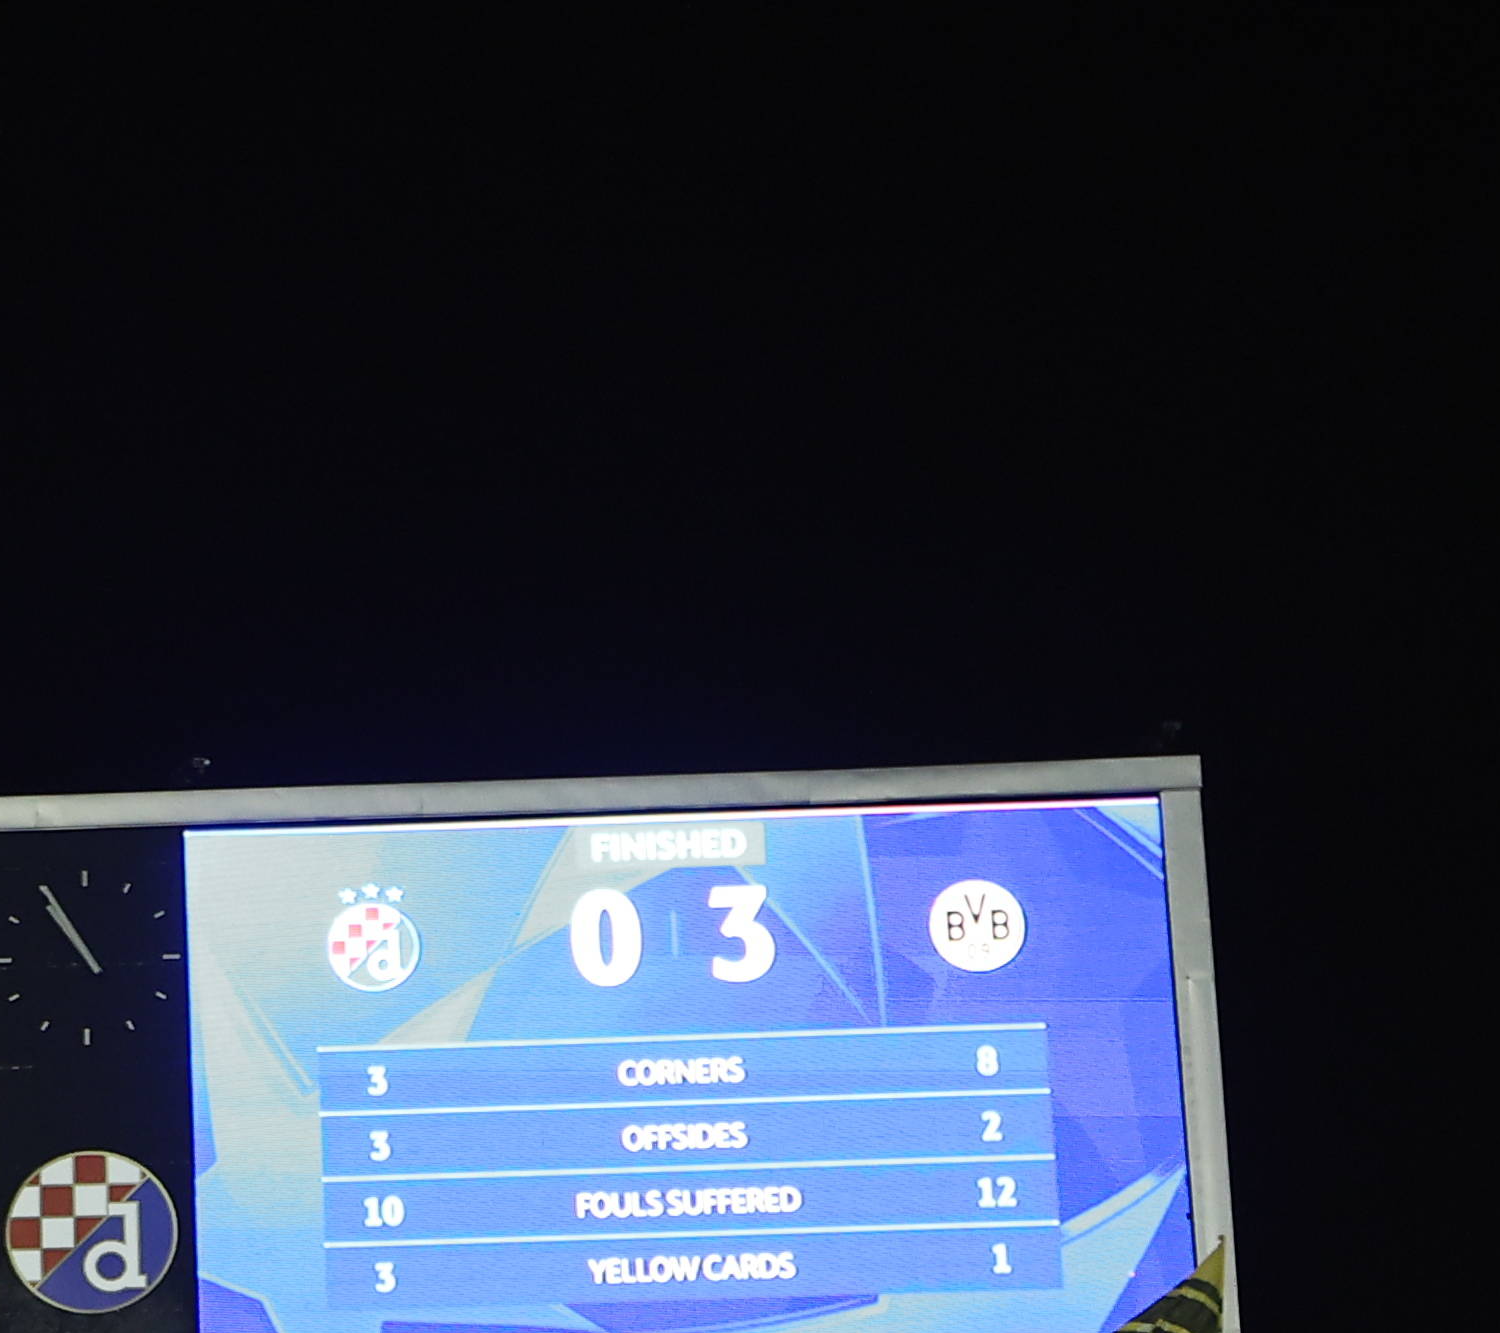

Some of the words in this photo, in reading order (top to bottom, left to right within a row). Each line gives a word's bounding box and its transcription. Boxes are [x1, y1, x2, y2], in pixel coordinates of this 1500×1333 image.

[590, 828, 747, 862] FINISHED
[571, 888, 643, 987] 0
[708, 884, 776, 983] 3
[946, 893, 1010, 941] BVB
[367, 1066, 388, 1096] 3
[616, 1056, 746, 1086] CORNERS
[976, 1045, 999, 1076] 8
[369, 1131, 391, 1161] 3
[621, 1121, 748, 1152] OFFSIDES
[981, 1111, 1003, 1142] 2
[363, 1195, 405, 1227] 10
[575, 1189, 664, 1218] FOULS
[665, 1186, 802, 1216] SUFFERED
[977, 1176, 1018, 1208] 12
[375, 1262, 397, 1293] 3
[587, 1255, 700, 1284] YELLOW
[702, 1251, 797, 1281] CARDS
[992, 1244, 1012, 1274] 1
